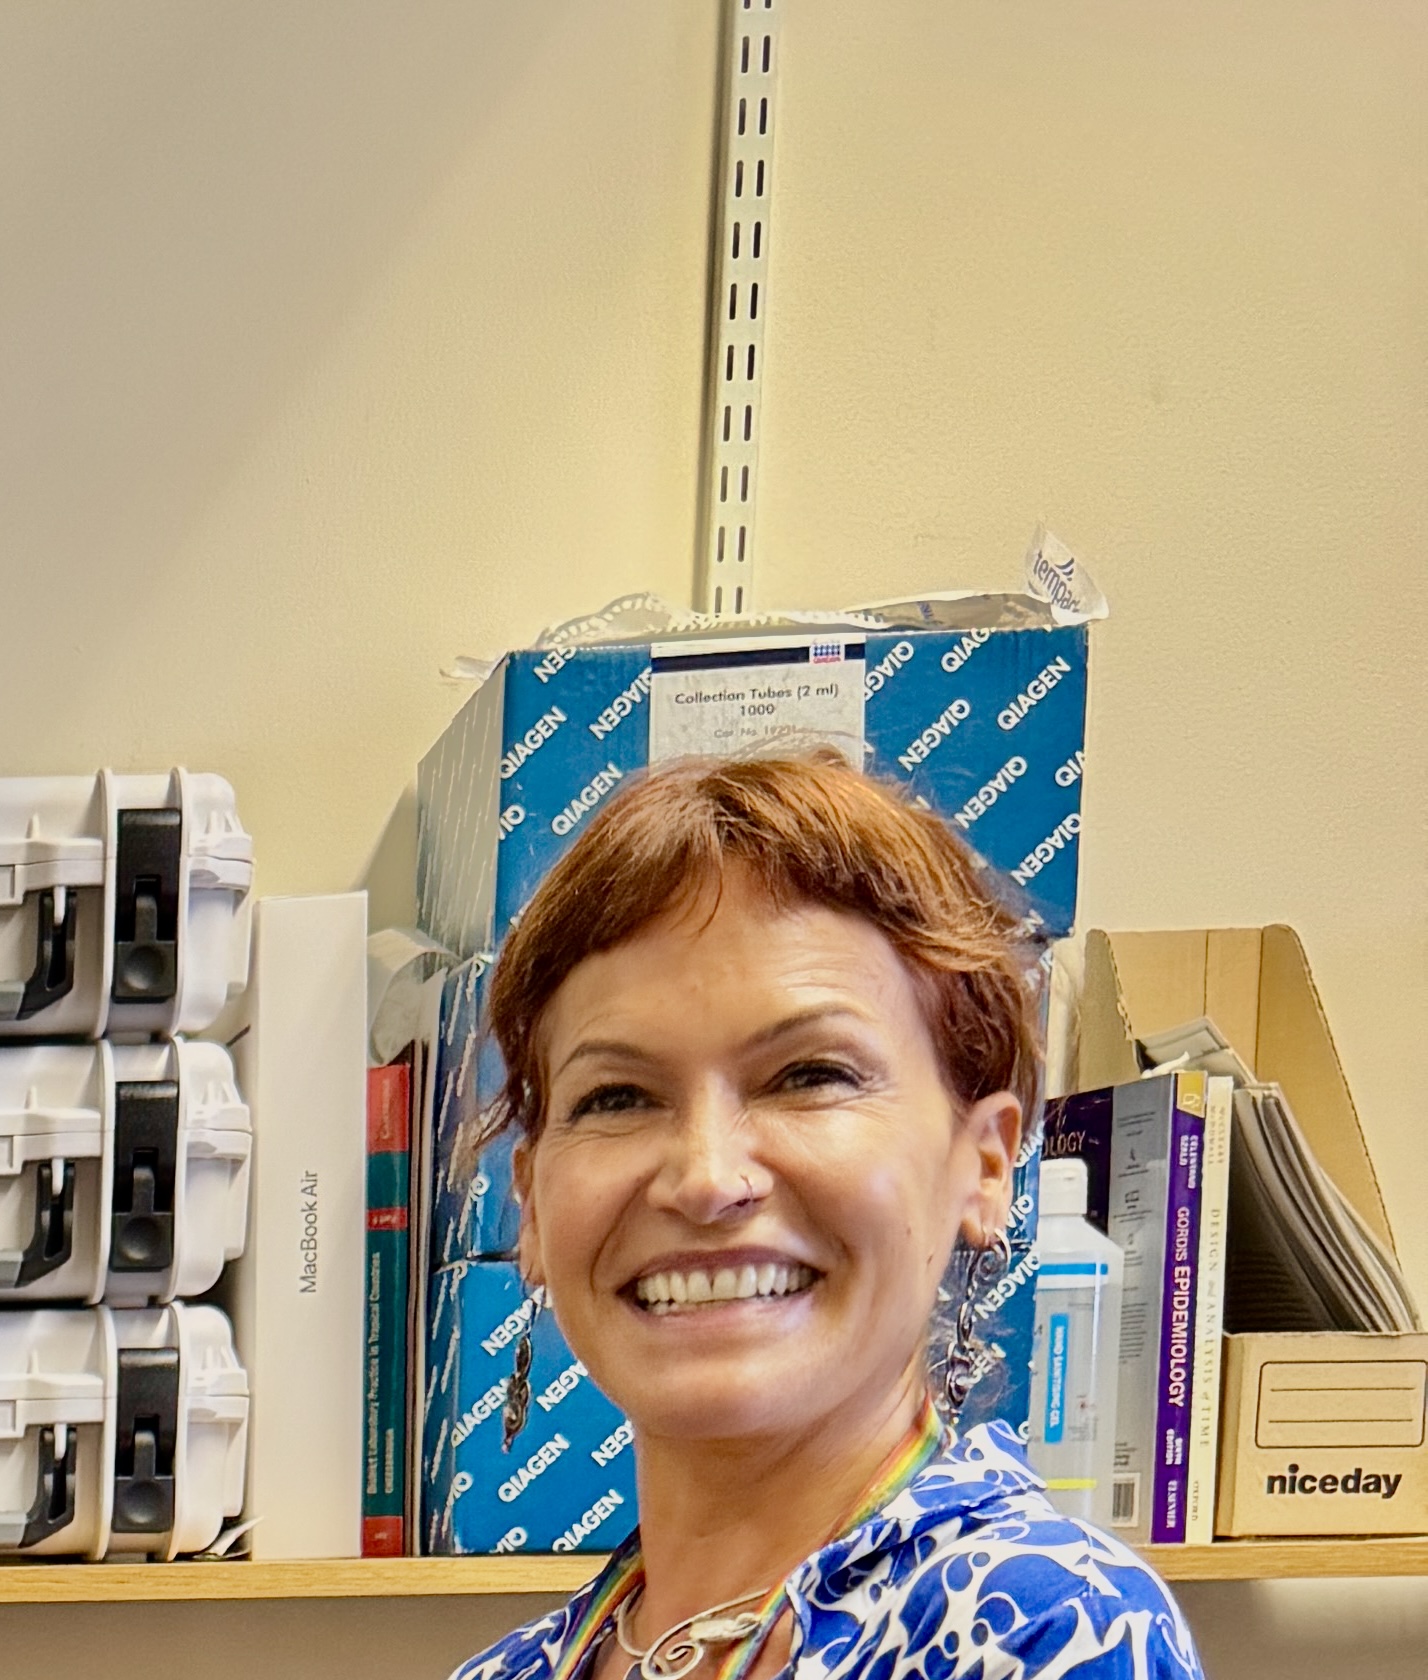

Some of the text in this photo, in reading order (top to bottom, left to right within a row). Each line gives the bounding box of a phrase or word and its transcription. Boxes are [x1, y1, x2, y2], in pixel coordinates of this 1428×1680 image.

[675, 683, 840, 705] Collection Tubes (2 ml)
[739, 703, 776, 717] 1000
[997, 656, 1072, 731] QIAGEN
[500, 705, 568, 779] QIAGEN
[898, 699, 971, 772] QIAGEN
[551, 762, 624, 836] QIAGEN
[954, 755, 1028, 829] QIAGEN
[1010, 812, 1080, 886] QIAGEN
[300, 1169, 319, 1294] MacBook Air
[1208, 1208, 1220, 1271] DESIGN
[1168, 1206, 1191, 1408] GORDIS EPIDEMIOLOGY
[1202, 1302, 1217, 1384] ANALYSIS
[1200, 1406, 1211, 1447] TIME
[498, 1433, 571, 1503] QIAGEN
[1266, 1463, 1403, 1499] niceday
